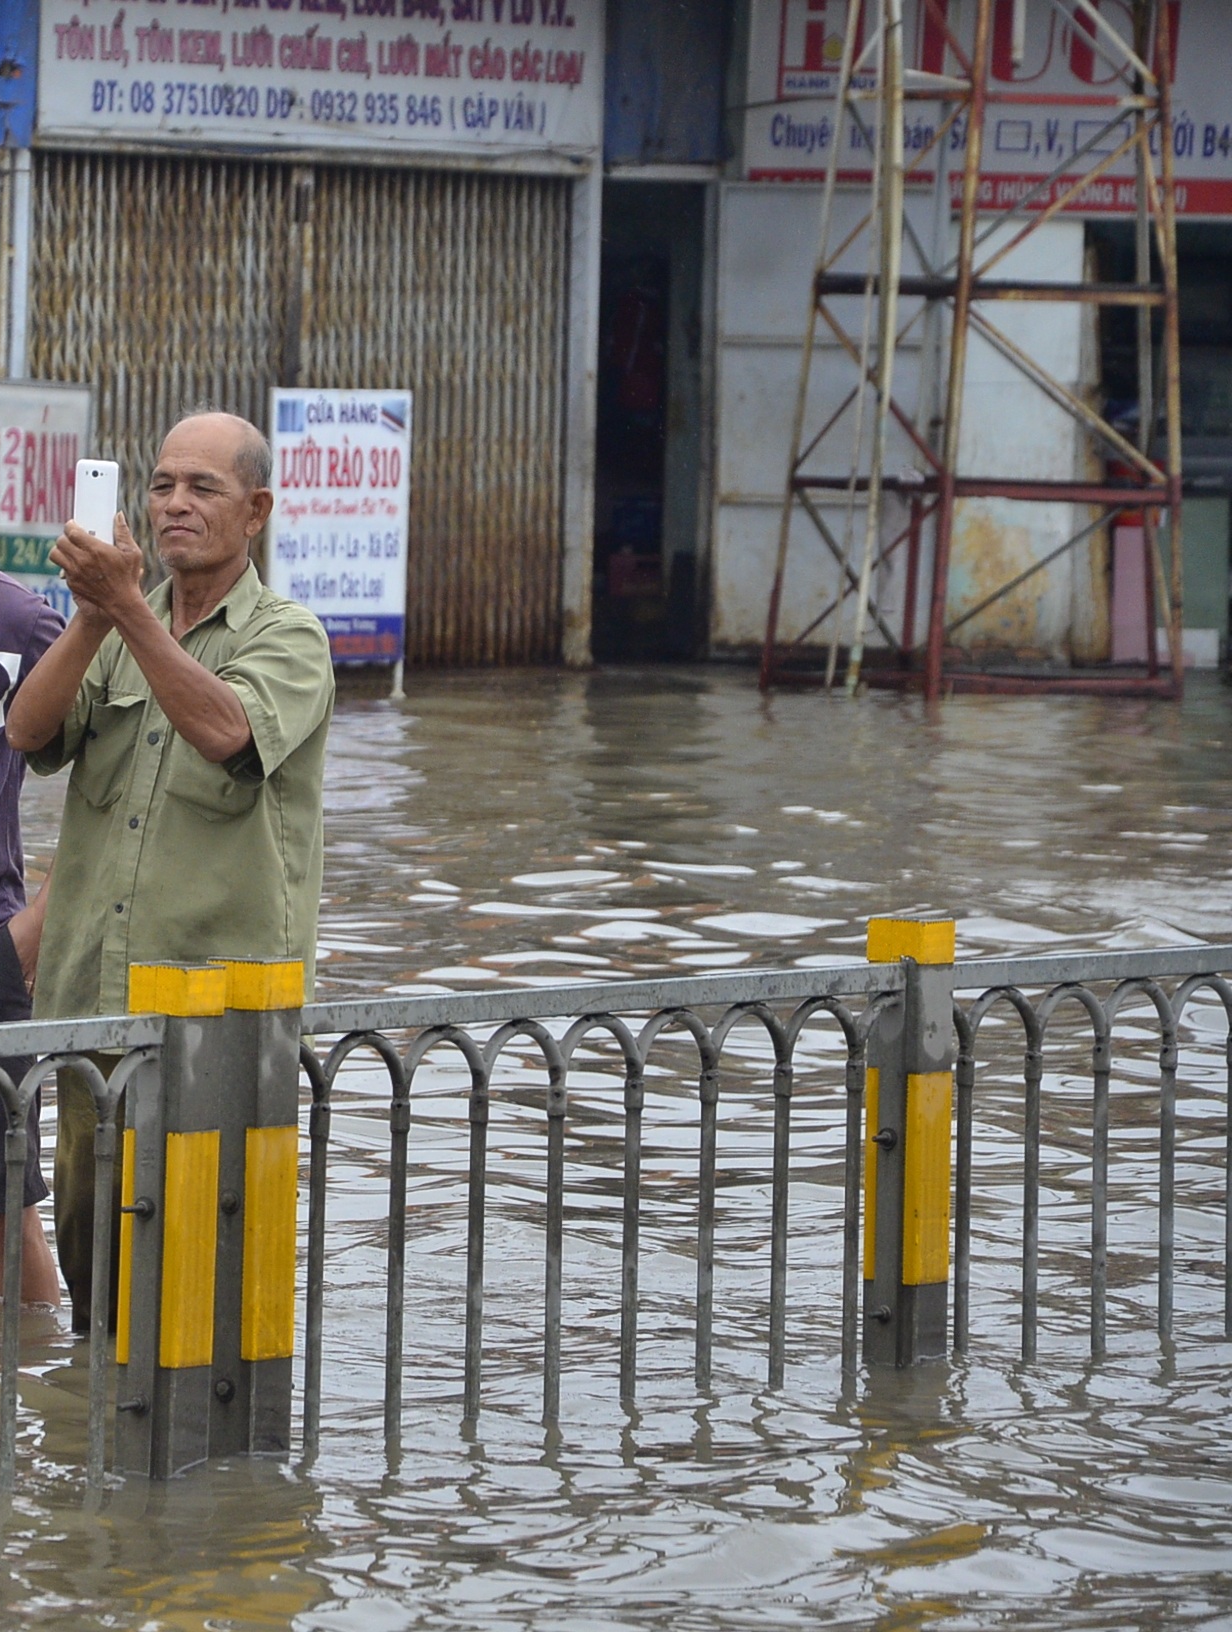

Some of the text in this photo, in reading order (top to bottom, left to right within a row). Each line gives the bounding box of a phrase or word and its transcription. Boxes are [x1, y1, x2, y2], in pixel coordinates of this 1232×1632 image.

[54, 15, 95, 60] TÔN
[135, 18, 174, 63] TÔN
[92, 79, 124, 112] ĐT:
[131, 80, 155, 113] 08
[311, 88, 358, 122] 0932
[364, 92, 399, 125] 935
[405, 94, 442, 126] 846
[771, 112, 833, 153] Chuyê
[1149, 110, 1194, 156] LỚI
[340, 397, 378, 424] HÀNG
[3, 426, 22, 465] 2
[24, 404, 79, 523] BÁNH
[327, 434, 364, 489] RÀO
[369, 446, 402, 489] 310
[0, 483, 18, 521] 4
[12, 536, 56, 568] 24/2
